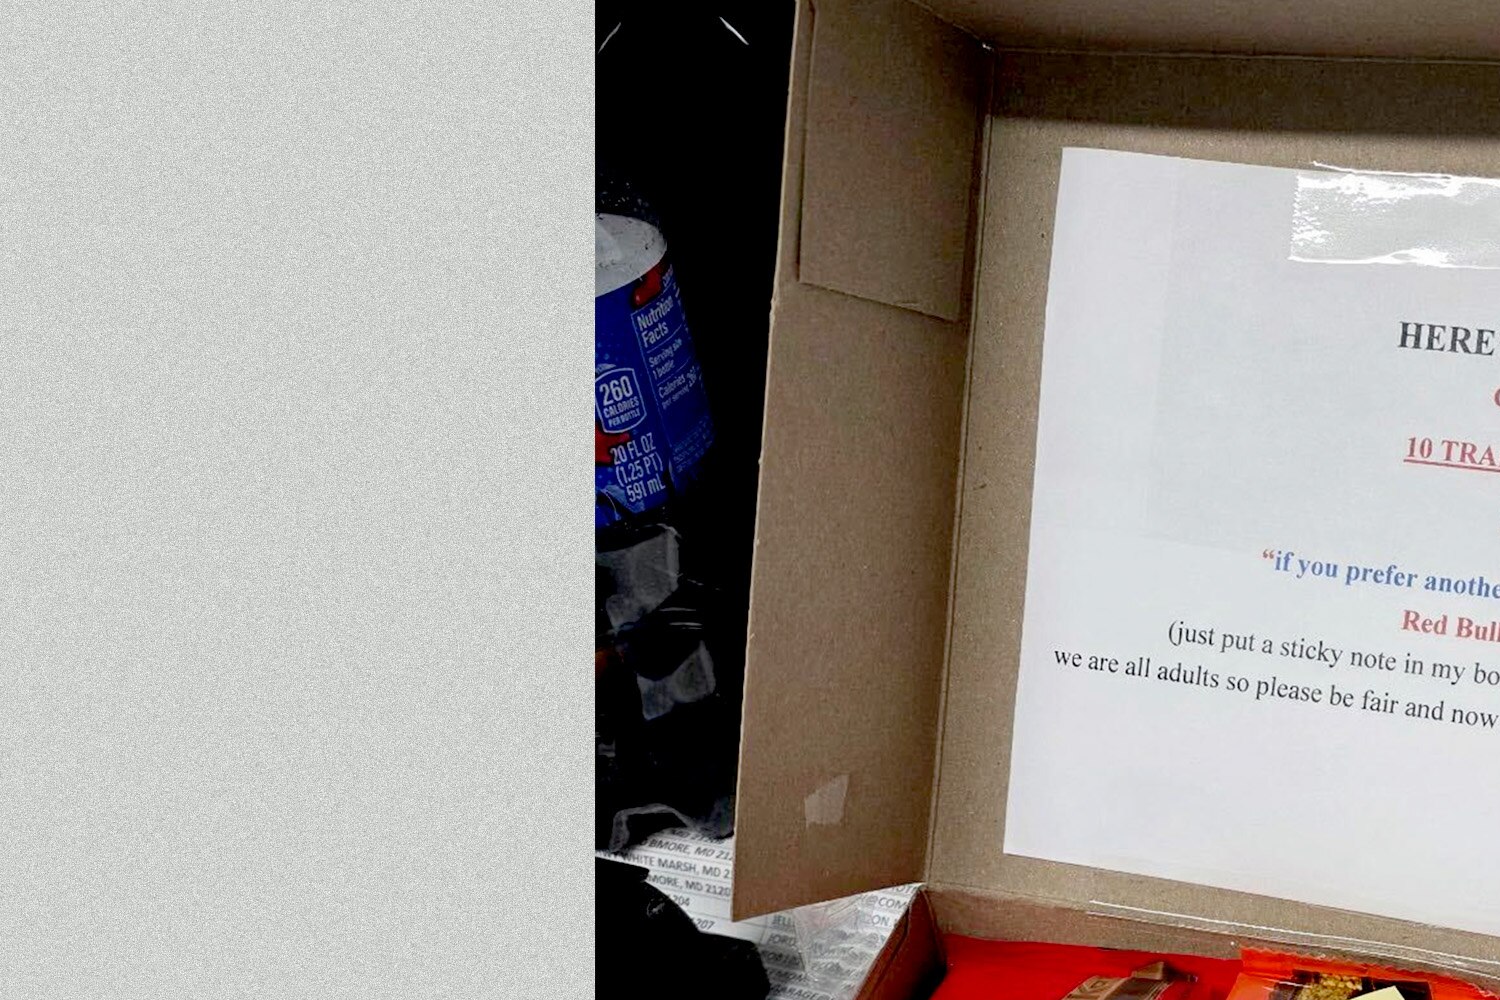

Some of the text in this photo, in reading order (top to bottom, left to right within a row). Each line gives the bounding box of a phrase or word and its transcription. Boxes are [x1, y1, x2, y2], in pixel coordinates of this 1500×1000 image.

[641, 321, 669, 348] Facts
[599, 375, 633, 406] 260
[609, 431, 656, 466] 20 FL OZ
[1407, 436, 1433, 459] 10
[615, 451, 664, 488] (1.25 PT)
[626, 473, 666, 503] 591 mL
[1296, 559, 1338, 579] you
[1345, 564, 1419, 588] prefer
[1402, 609, 1448, 635] Red
[1168, 620, 1215, 647] (just
[1219, 633, 1256, 654] put
[1261, 639, 1273, 655] a
[1279, 637, 1344, 669] sticky
[1350, 651, 1397, 672] note
[1404, 652, 1424, 676] in
[1431, 662, 1466, 686] my
[1054, 650, 1083, 668] we
[1087, 655, 1120, 674] are
[1124, 656, 1151, 678] all
[1156, 662, 1220, 689] adults
[1225, 676, 1250, 693] so
[1255, 676, 1323, 704] please
[1329, 684, 1355, 708] be
[1360, 689, 1400, 714] fair
[1404, 700, 1445, 722] and
[1450, 708, 1499, 729] now
